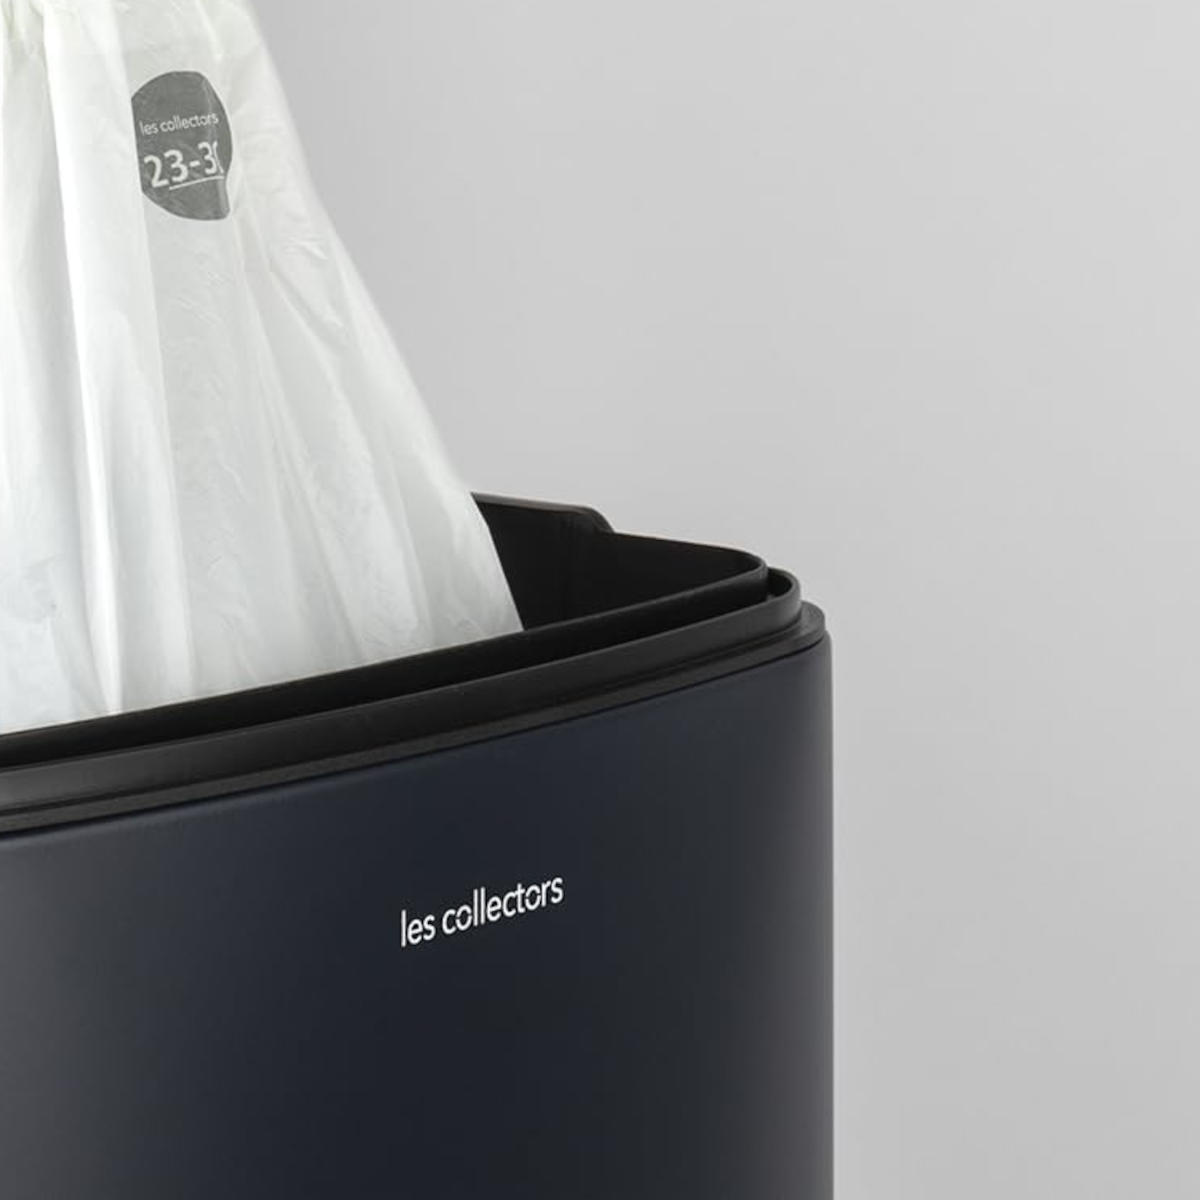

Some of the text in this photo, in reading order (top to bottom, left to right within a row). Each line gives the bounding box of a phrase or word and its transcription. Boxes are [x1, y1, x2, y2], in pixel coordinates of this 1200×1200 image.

[139, 112, 219, 135] les collectors
[401, 877, 563, 947] les collectors
